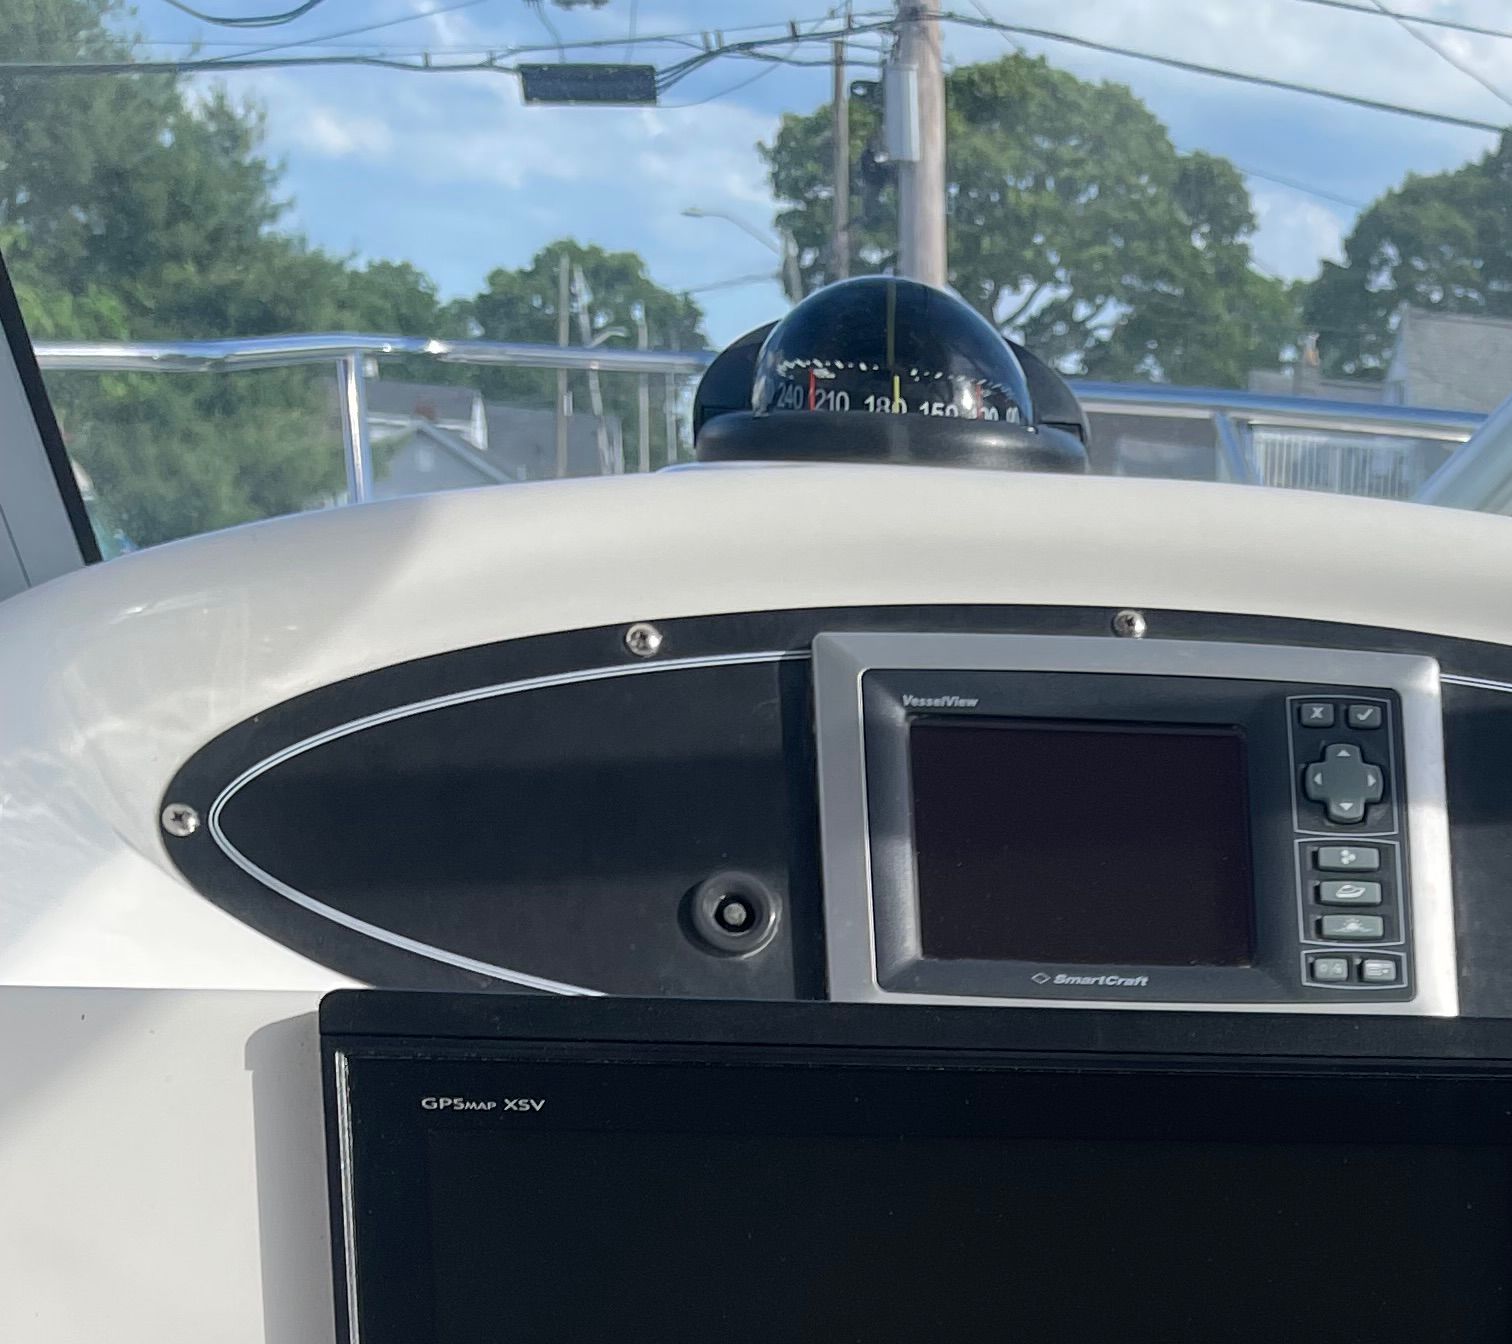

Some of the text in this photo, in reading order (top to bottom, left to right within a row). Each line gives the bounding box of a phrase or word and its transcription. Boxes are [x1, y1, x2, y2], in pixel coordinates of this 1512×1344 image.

[777, 383, 801, 409] 240
[815, 390, 850, 412] 210
[864, 395, 907, 415] 180
[902, 694, 979, 707] VesselView
[1053, 973, 1149, 986] SmartCraft
[503, 1098, 546, 1111] XSV
